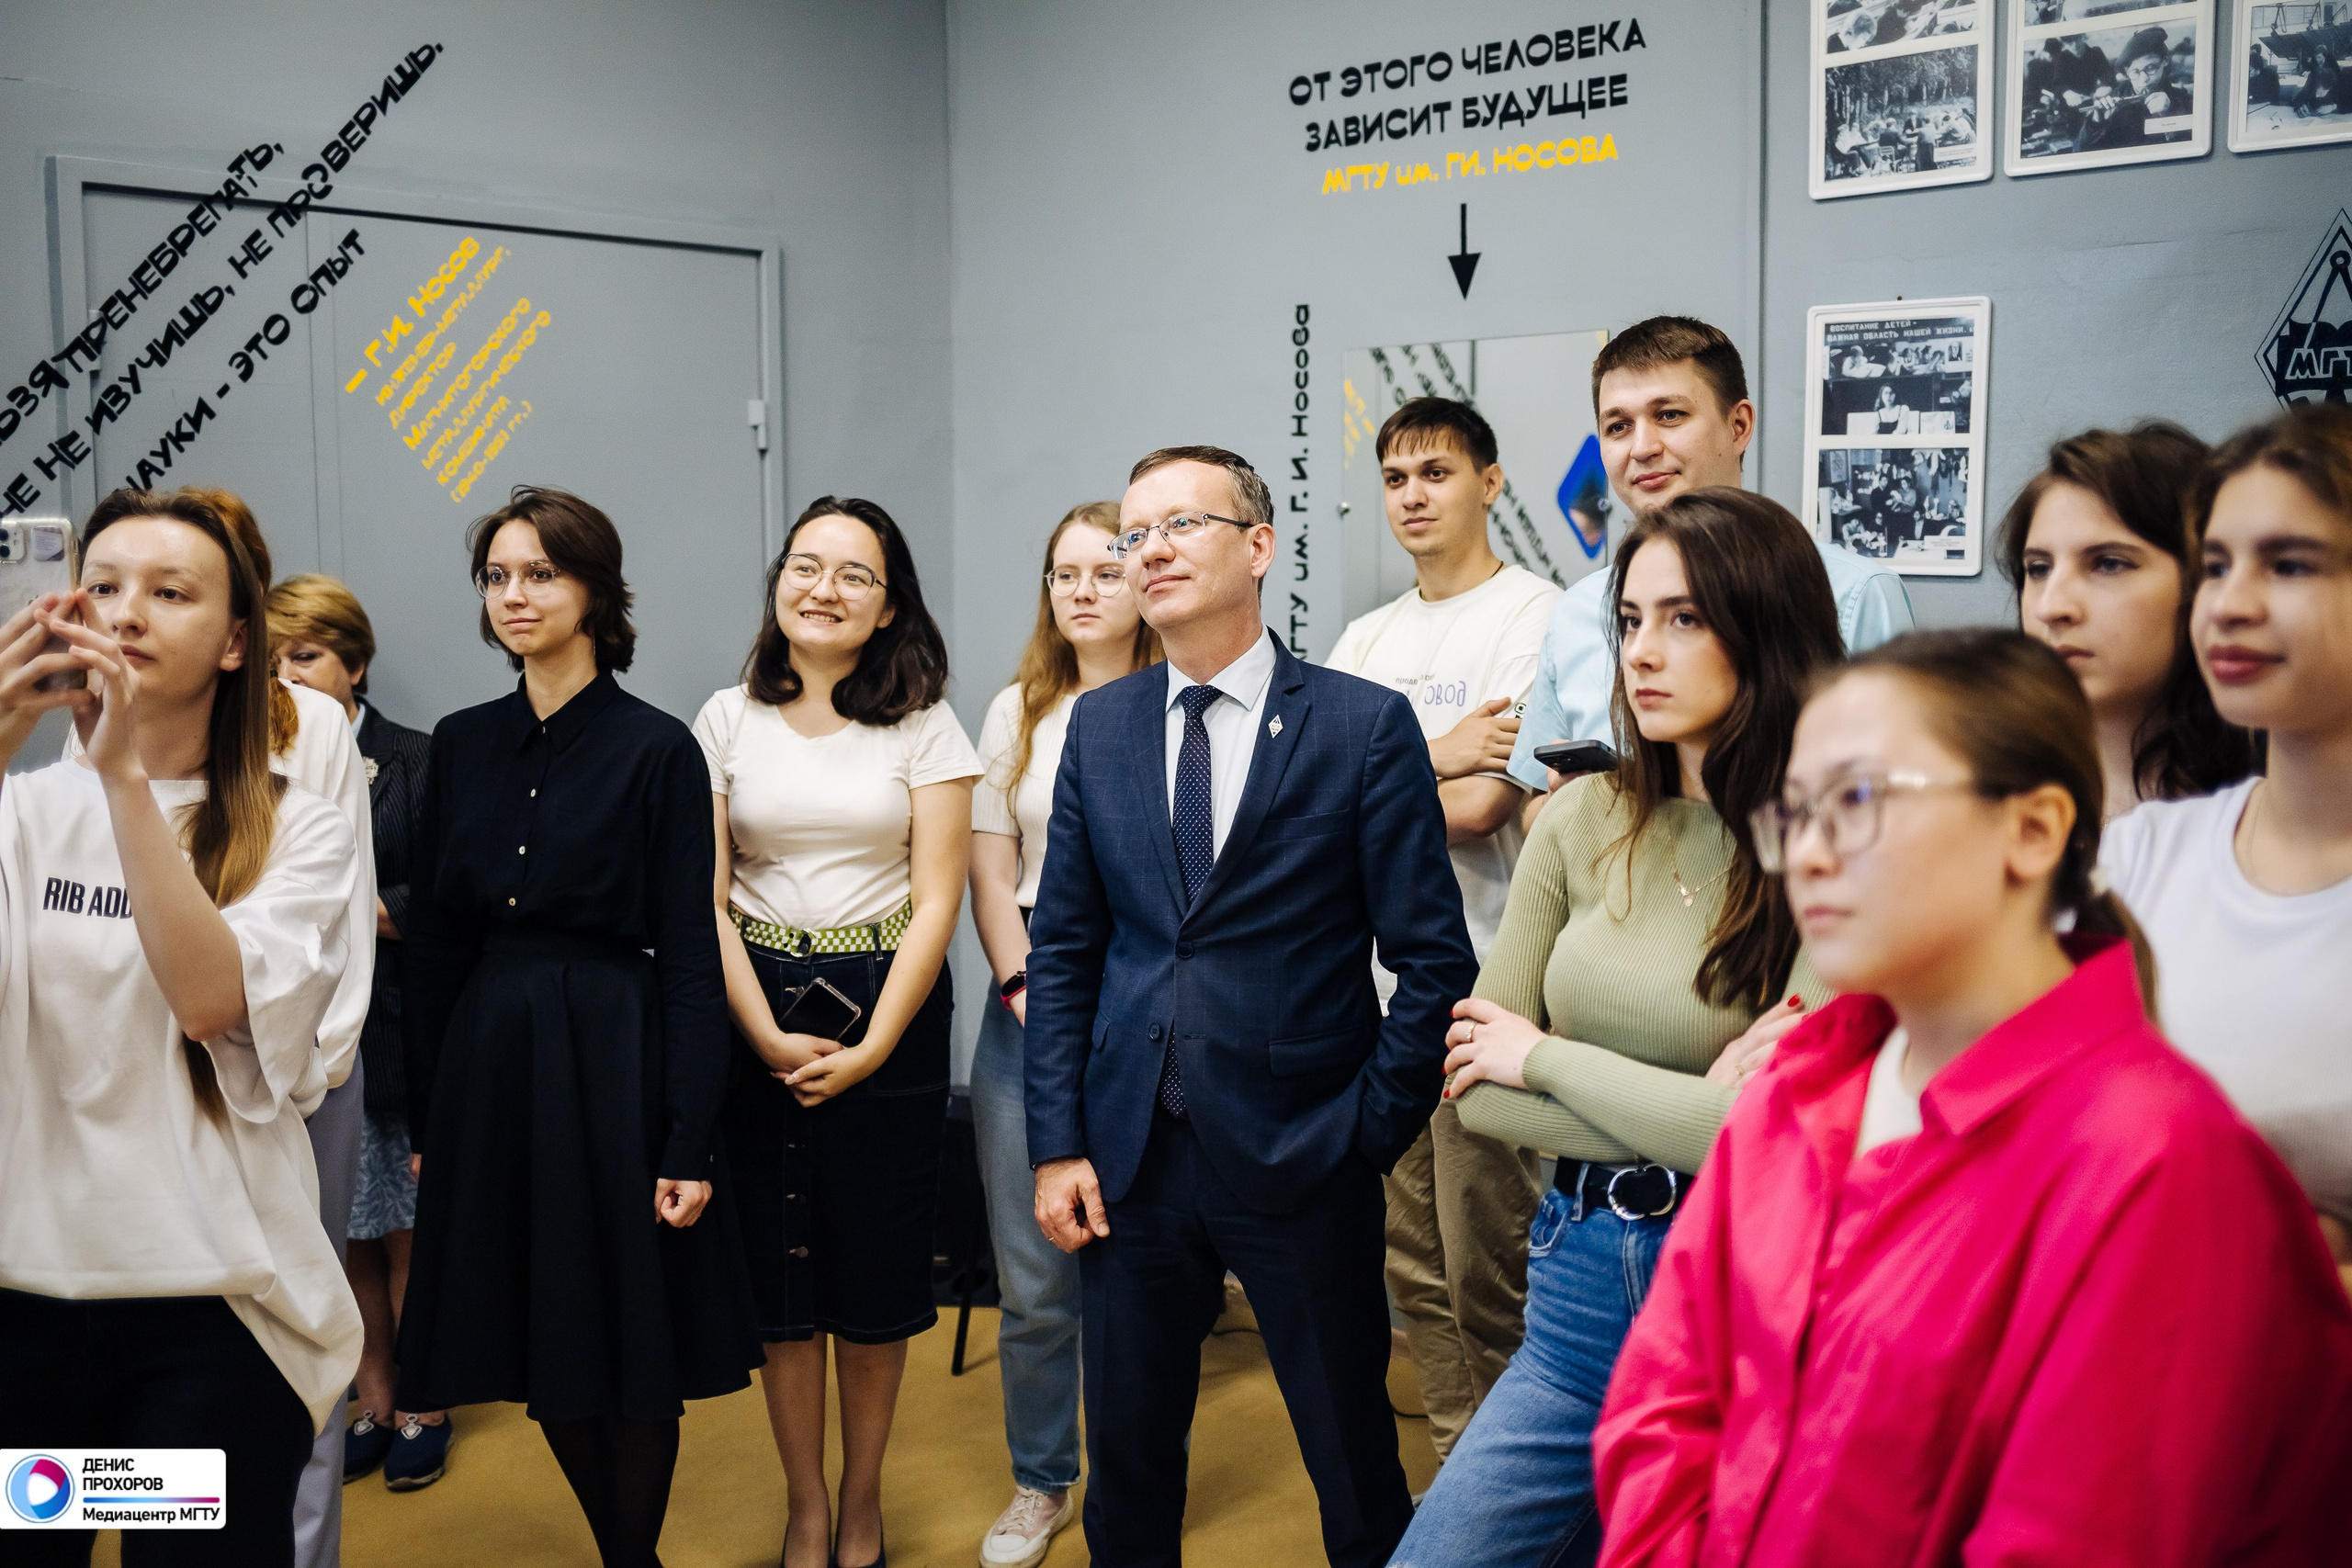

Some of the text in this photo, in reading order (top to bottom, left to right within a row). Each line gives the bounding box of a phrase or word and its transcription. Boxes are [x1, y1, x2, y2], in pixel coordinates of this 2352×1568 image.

[1288, 17, 1646, 106] ОТ ЭТОГО ЧЕЛОВЕКА
[1305, 73, 1629, 152] ЗАВИСИТ БУДУЩЕЕ
[1321, 162, 1390, 195] МГТУ
[1494, 133, 1619, 174] НОСОВА
[51, 142, 285, 373] ПРЕНЕБРЕГАТЬ,
[229, 314, 290, 383] ЭТО
[290, 228, 365, 316] ОПЫТ
[365, 315, 414, 367] Г.И.
[1826, 333, 1860, 343] ВАЖНАЯ
[1862, 331, 1900, 341] ОБЛАСТЬ
[1903, 326, 1931, 337] НАШЕЙ
[1829, 322, 1880, 333] ВОСПИТАНИЕ
[32, 430, 92, 481] НЕ
[85, 285, 236, 435] ИЗУЧИШЬ,
[227, 229, 273, 279] НЕ
[1291, 303, 1310, 438] Носова
[1290, 592, 1309, 660] ГТУ
[43, 876, 85, 915] RIB
